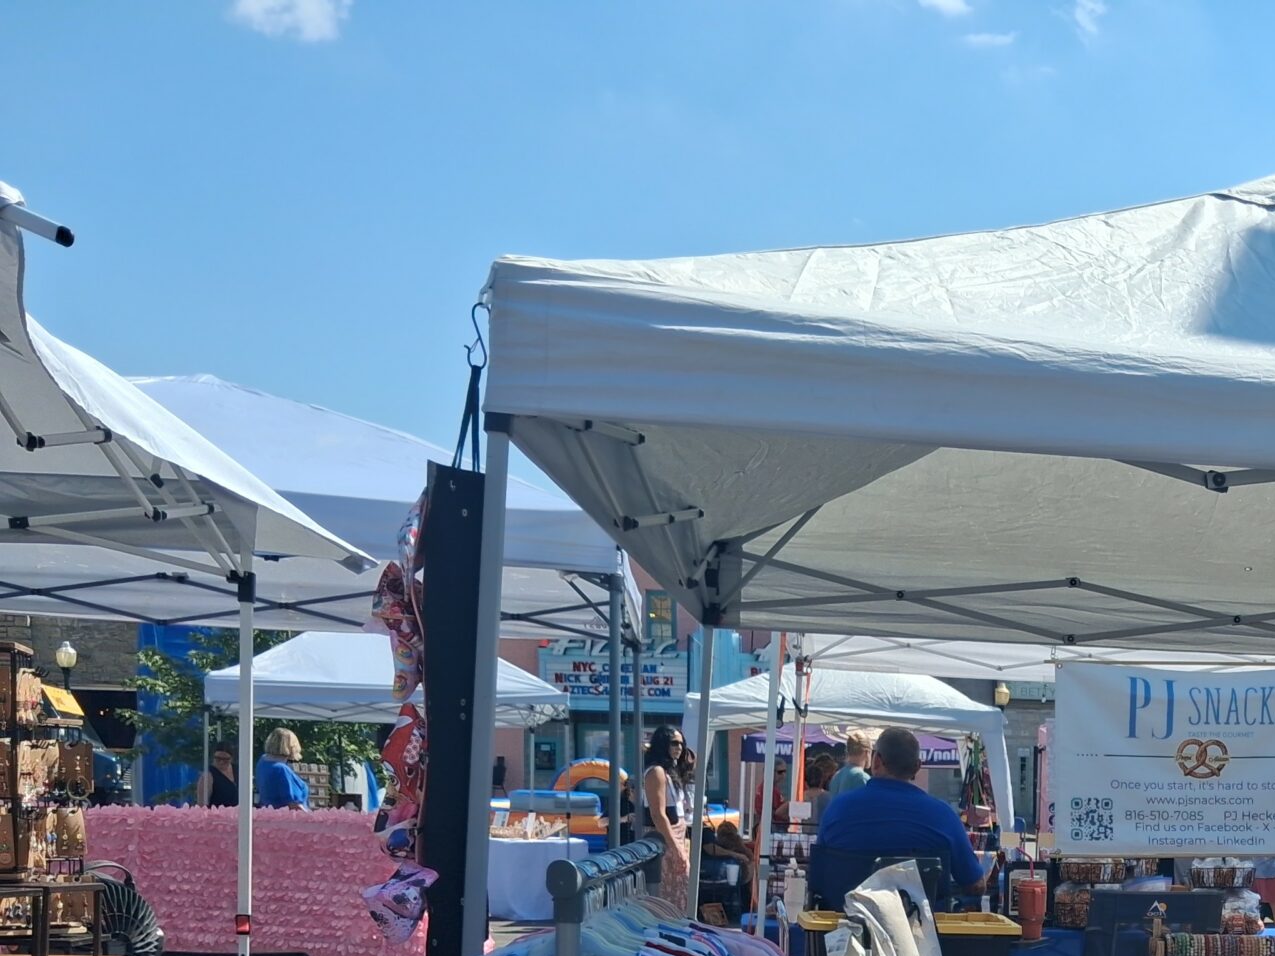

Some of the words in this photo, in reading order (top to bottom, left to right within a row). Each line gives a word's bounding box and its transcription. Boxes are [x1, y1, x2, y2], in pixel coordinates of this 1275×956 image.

[572, 661, 597, 673] NYC
[554, 673, 581, 684] NICK
[1127, 676, 1176, 739] PJ
[1110, 779, 1140, 790] Once
[1143, 782, 1164, 791] you
[1168, 780, 1196, 791] start,
[1199, 780, 1214, 790] it's
[1217, 780, 1243, 790] hard
[1246, 781, 1258, 790] to
[1146, 795, 1254, 807] www.pjsnacks.com
[1125, 811, 1204, 821] 816-510-7085
[1224, 811, 1238, 821] PJ
[1136, 823, 1161, 832] Find
[1198, 822, 1253, 832] Facebook
[1263, 823, 1270, 832] X
[1148, 836, 1206, 847] Instagram
[1217, 836, 1265, 846] LinkedIn
